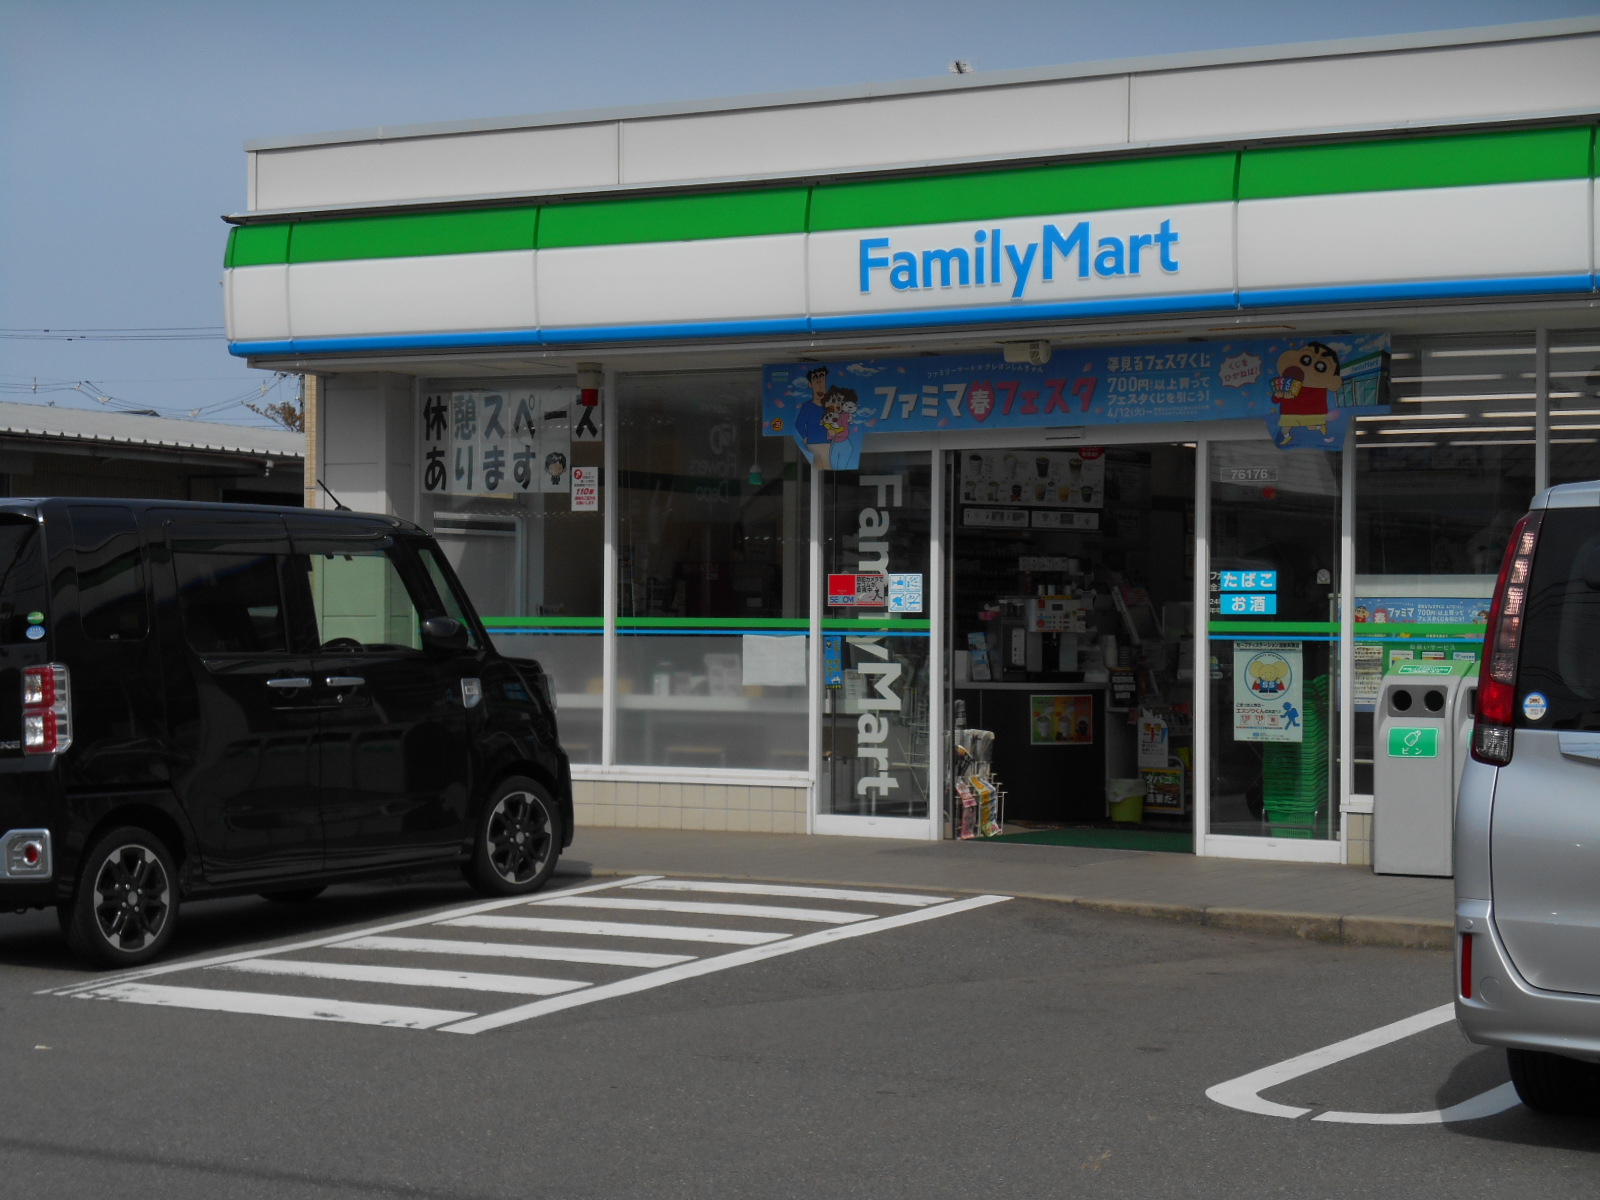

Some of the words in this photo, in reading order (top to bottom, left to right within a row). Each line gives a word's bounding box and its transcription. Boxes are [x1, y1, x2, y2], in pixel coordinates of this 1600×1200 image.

[859, 218, 1180, 299] FamilyMart
[423, 394, 598, 441] 休憩スペース
[424, 445, 536, 491] あります
[1231, 468, 1268, 480] 76176
[1223, 572, 1273, 588] たばこ
[1232, 596, 1266, 612] お酒
[1387, 607, 1415, 618] ファミマ
[846, 474, 903, 796] FamlyMart
[1402, 747, 1422, 755] ビン
